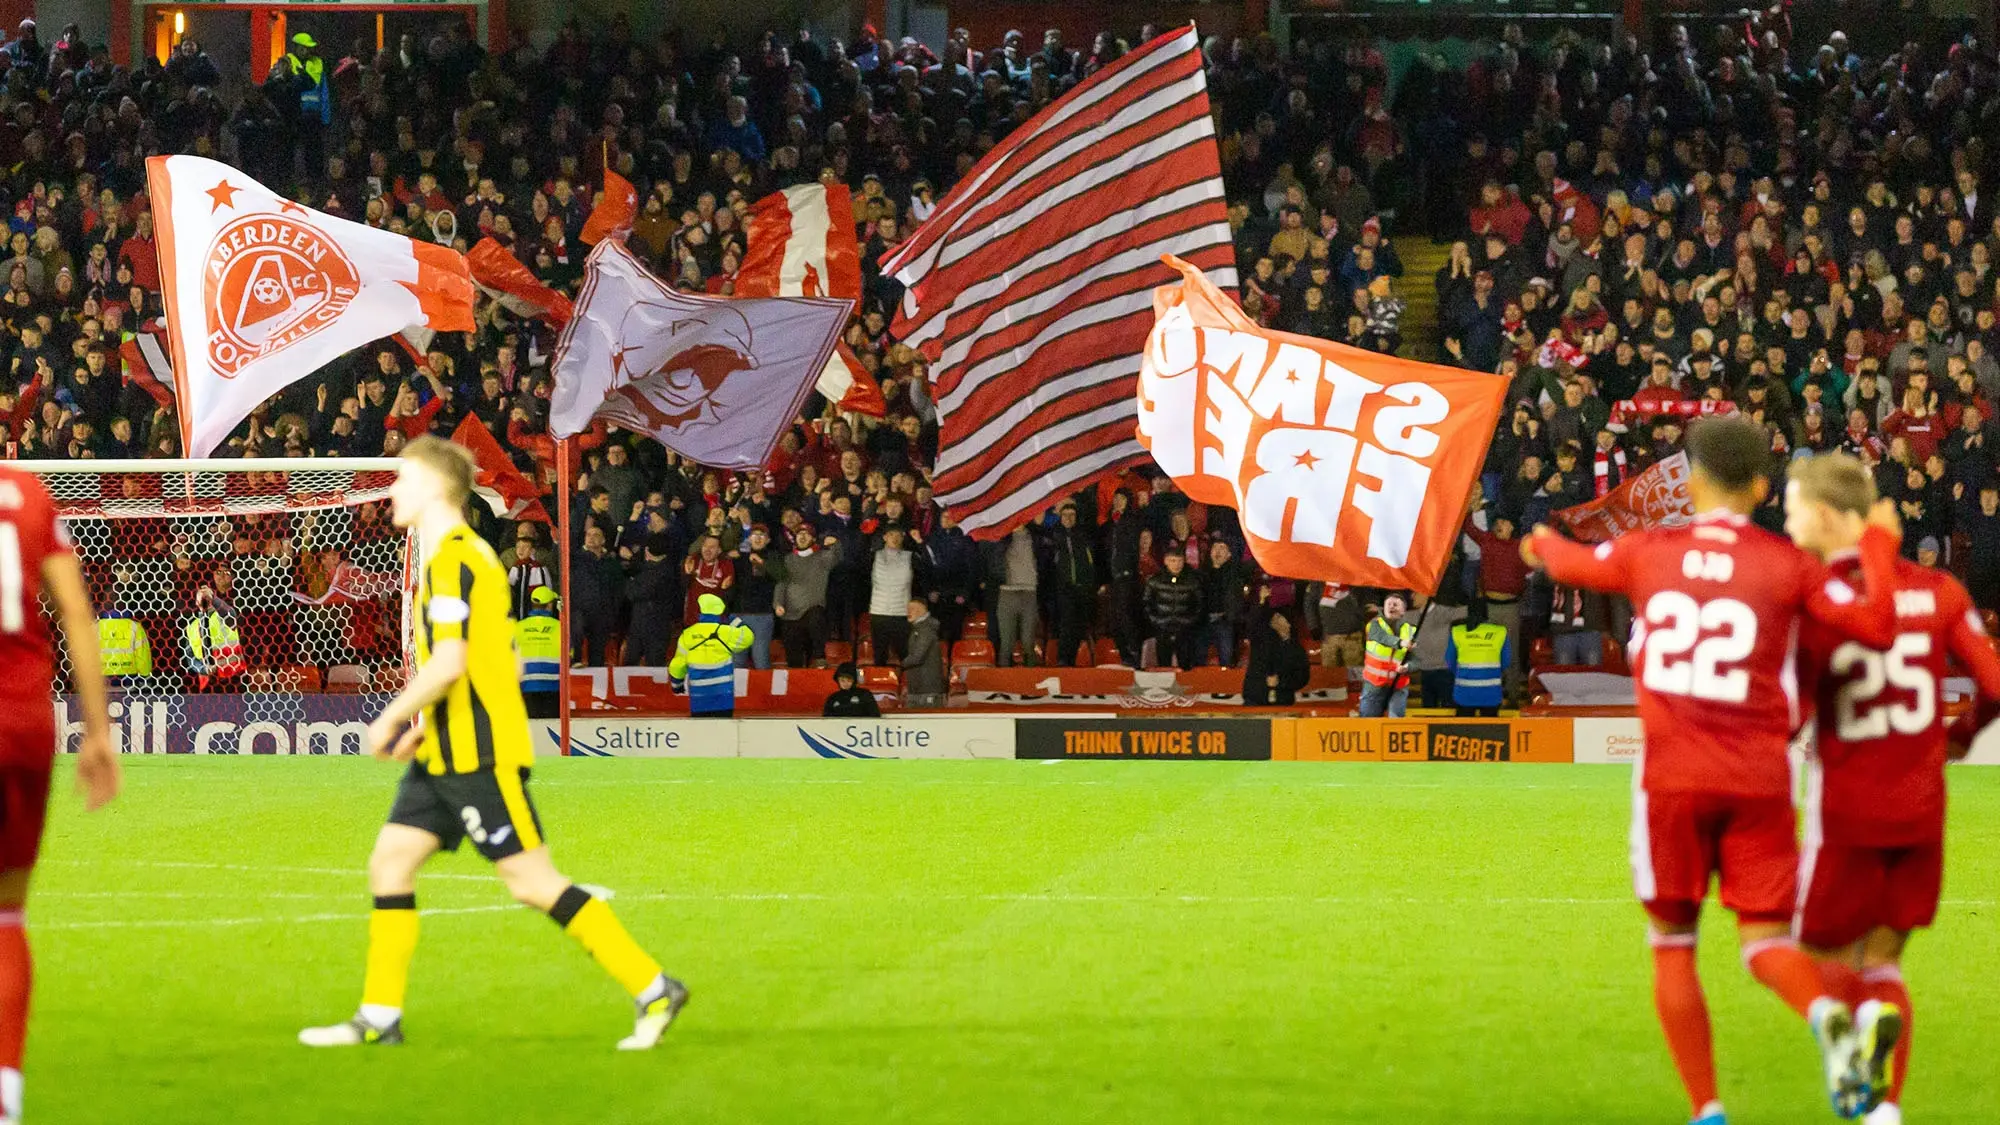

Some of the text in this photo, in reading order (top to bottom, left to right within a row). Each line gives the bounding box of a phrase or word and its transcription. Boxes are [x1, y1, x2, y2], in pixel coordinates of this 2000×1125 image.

[209, 223, 327, 279] ABERDEEN
[290, 272, 319, 291] FC
[208, 322, 317, 370] FOOBALL
[1643, 590, 1758, 703] 22
[1830, 633, 1936, 742] 25
[595, 726, 680, 749] Saltire
[845, 725, 930, 748] Saltire
[1064, 731, 1226, 754] THINK TWICE OR
[1318, 731, 1532, 761] YOU'LL BET REGRET IT
